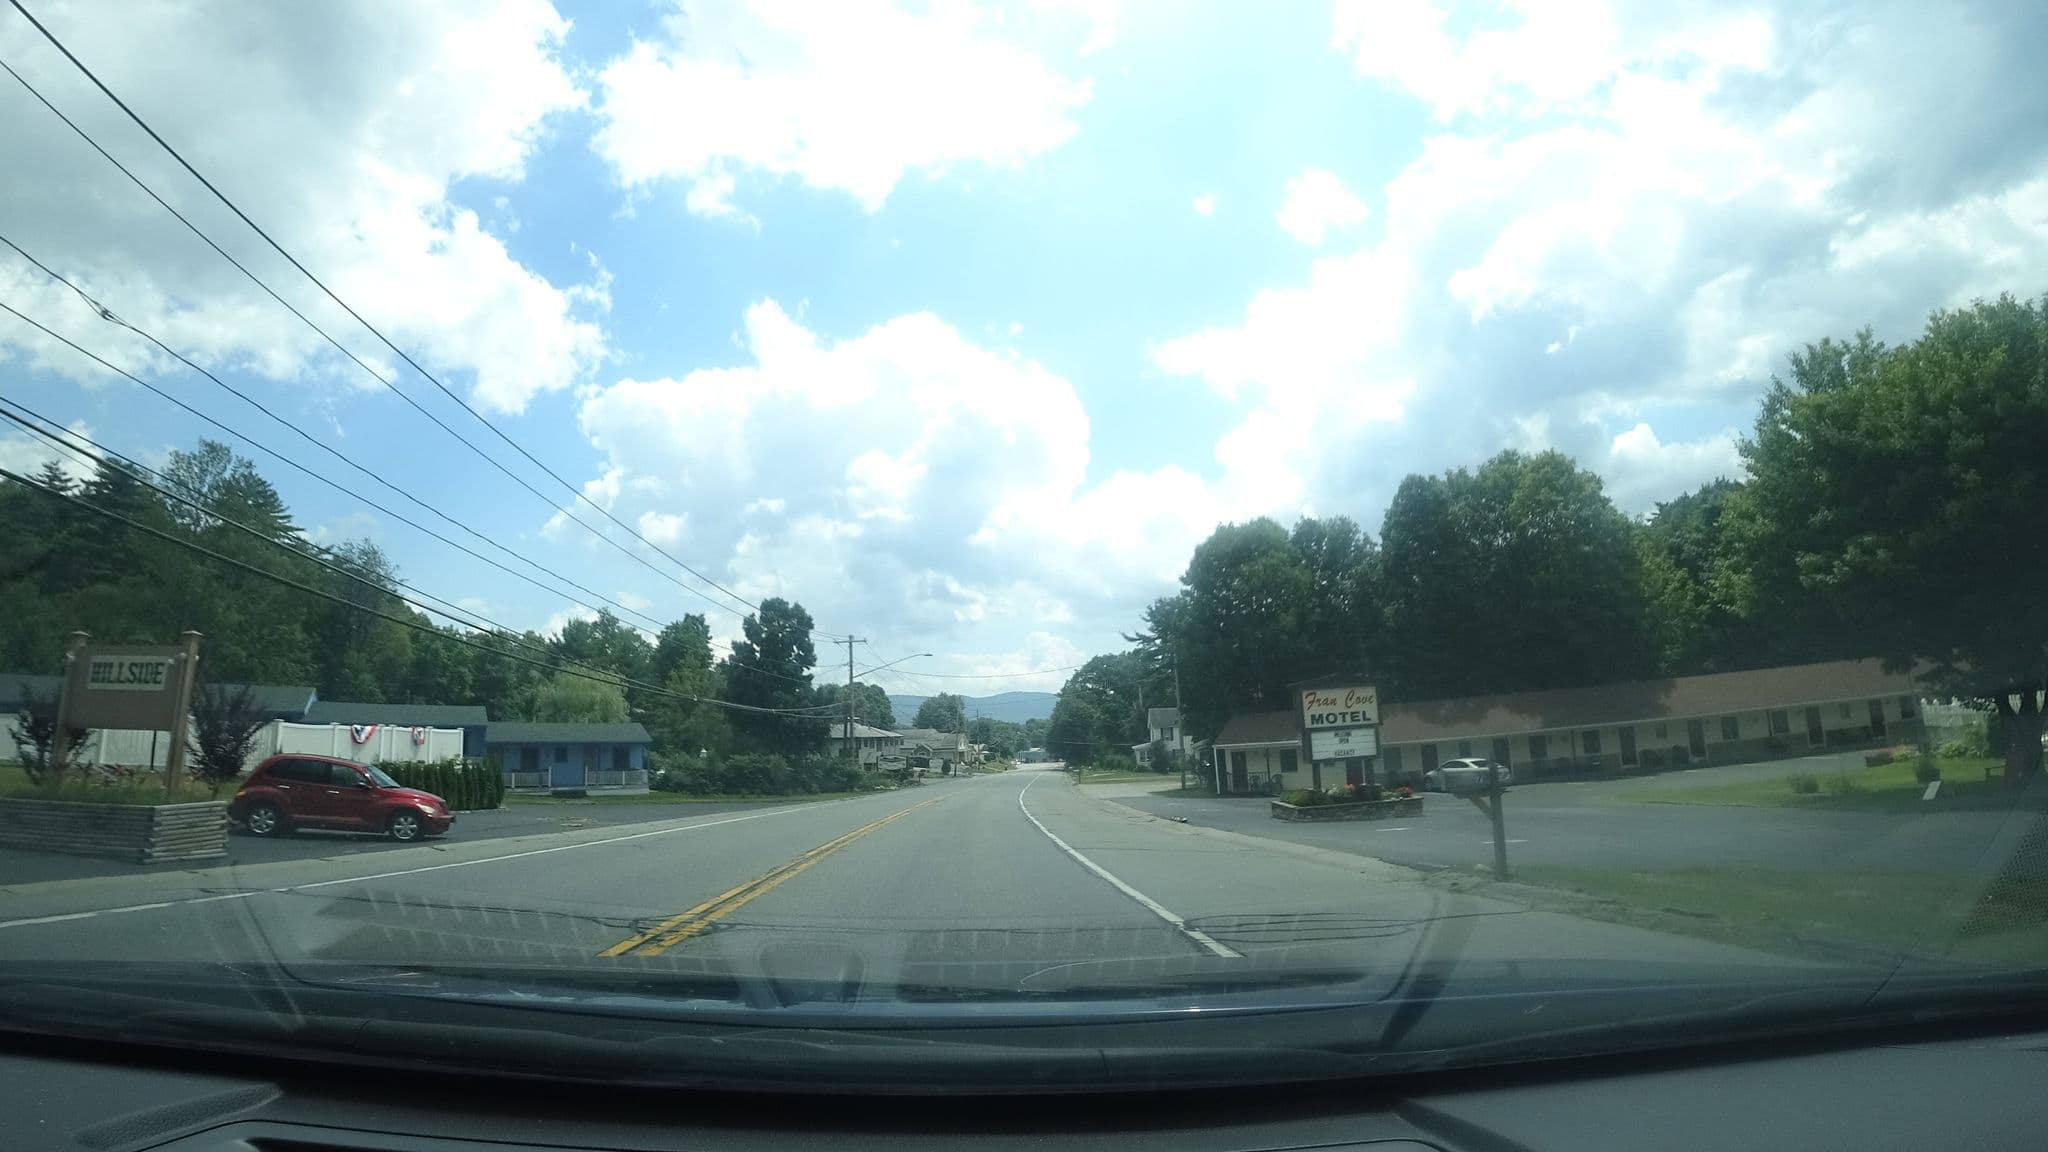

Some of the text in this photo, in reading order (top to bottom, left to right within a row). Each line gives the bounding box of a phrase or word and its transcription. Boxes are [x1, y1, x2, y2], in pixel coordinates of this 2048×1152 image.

[91, 662, 165, 684] HILLSIDE
[1305, 689, 1374, 711] Fran Cove
[1310, 711, 1371, 725] MOTEL
